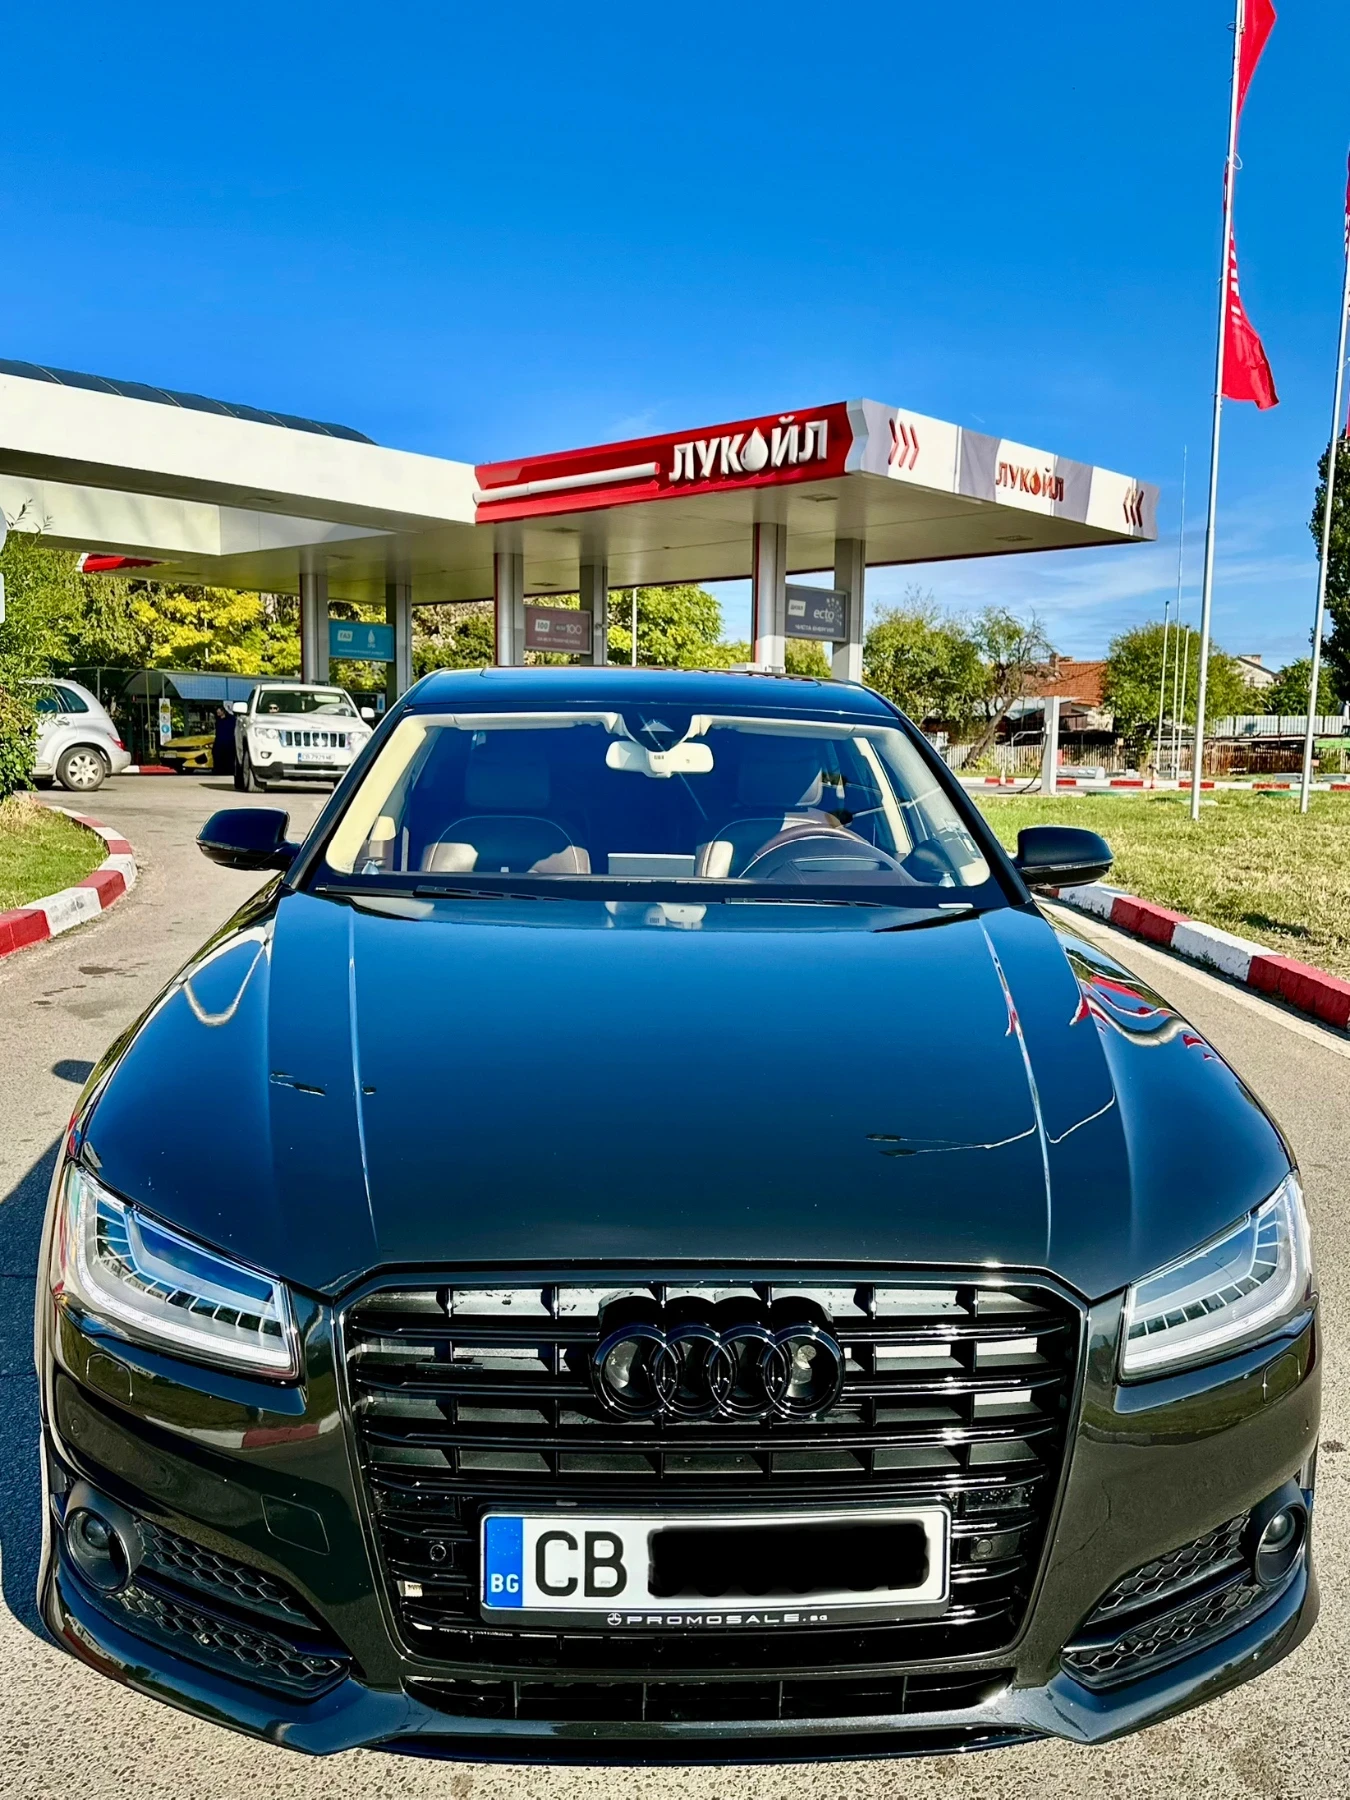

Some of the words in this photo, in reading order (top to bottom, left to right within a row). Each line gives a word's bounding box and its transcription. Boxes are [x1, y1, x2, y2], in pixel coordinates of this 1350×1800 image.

[668, 414, 828, 482] ЛУКОЙЛ
[996, 461, 1065, 502] ЛУКОЙЛ
[813, 608, 835, 620] ecto
[537, 621, 549, 630] 100
[535, 1530, 628, 1598] CB
[490, 1573, 519, 1593] BG
[627, 1613, 828, 1625] PROMOSALE.BG
